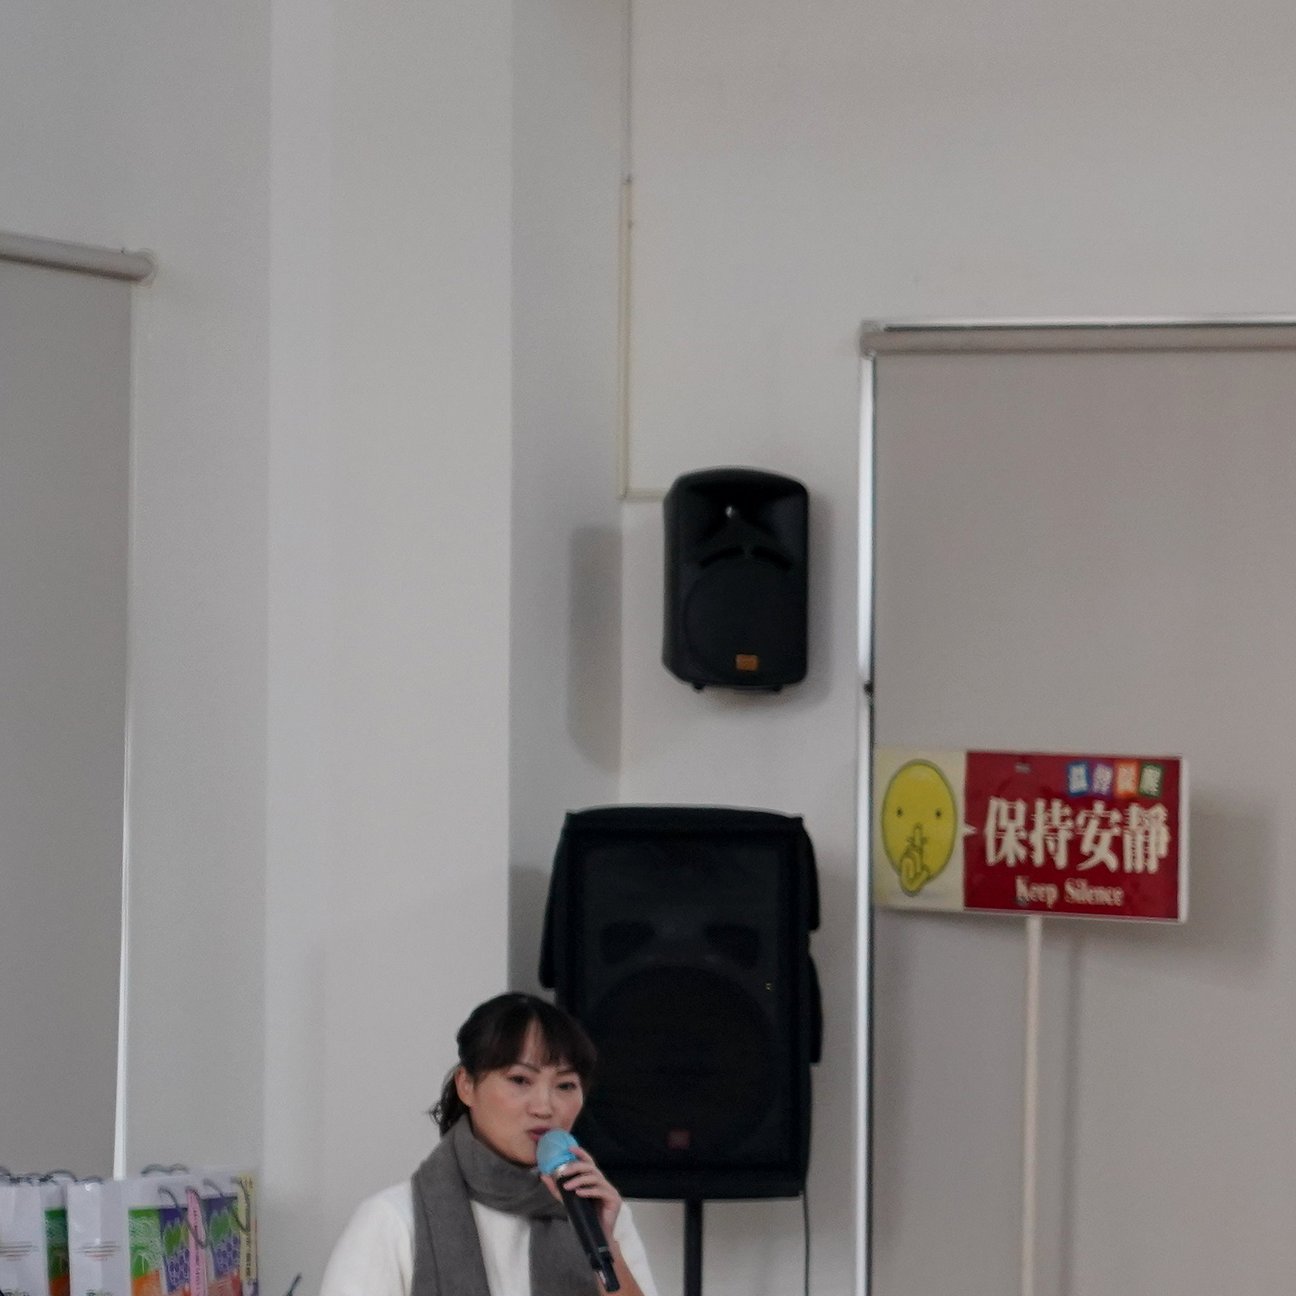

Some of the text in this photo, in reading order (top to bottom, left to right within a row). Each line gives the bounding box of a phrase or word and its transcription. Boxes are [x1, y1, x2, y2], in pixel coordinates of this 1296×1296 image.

[983, 796, 1171, 874] 保持安靜
[1015, 875, 1058, 908] Keep
